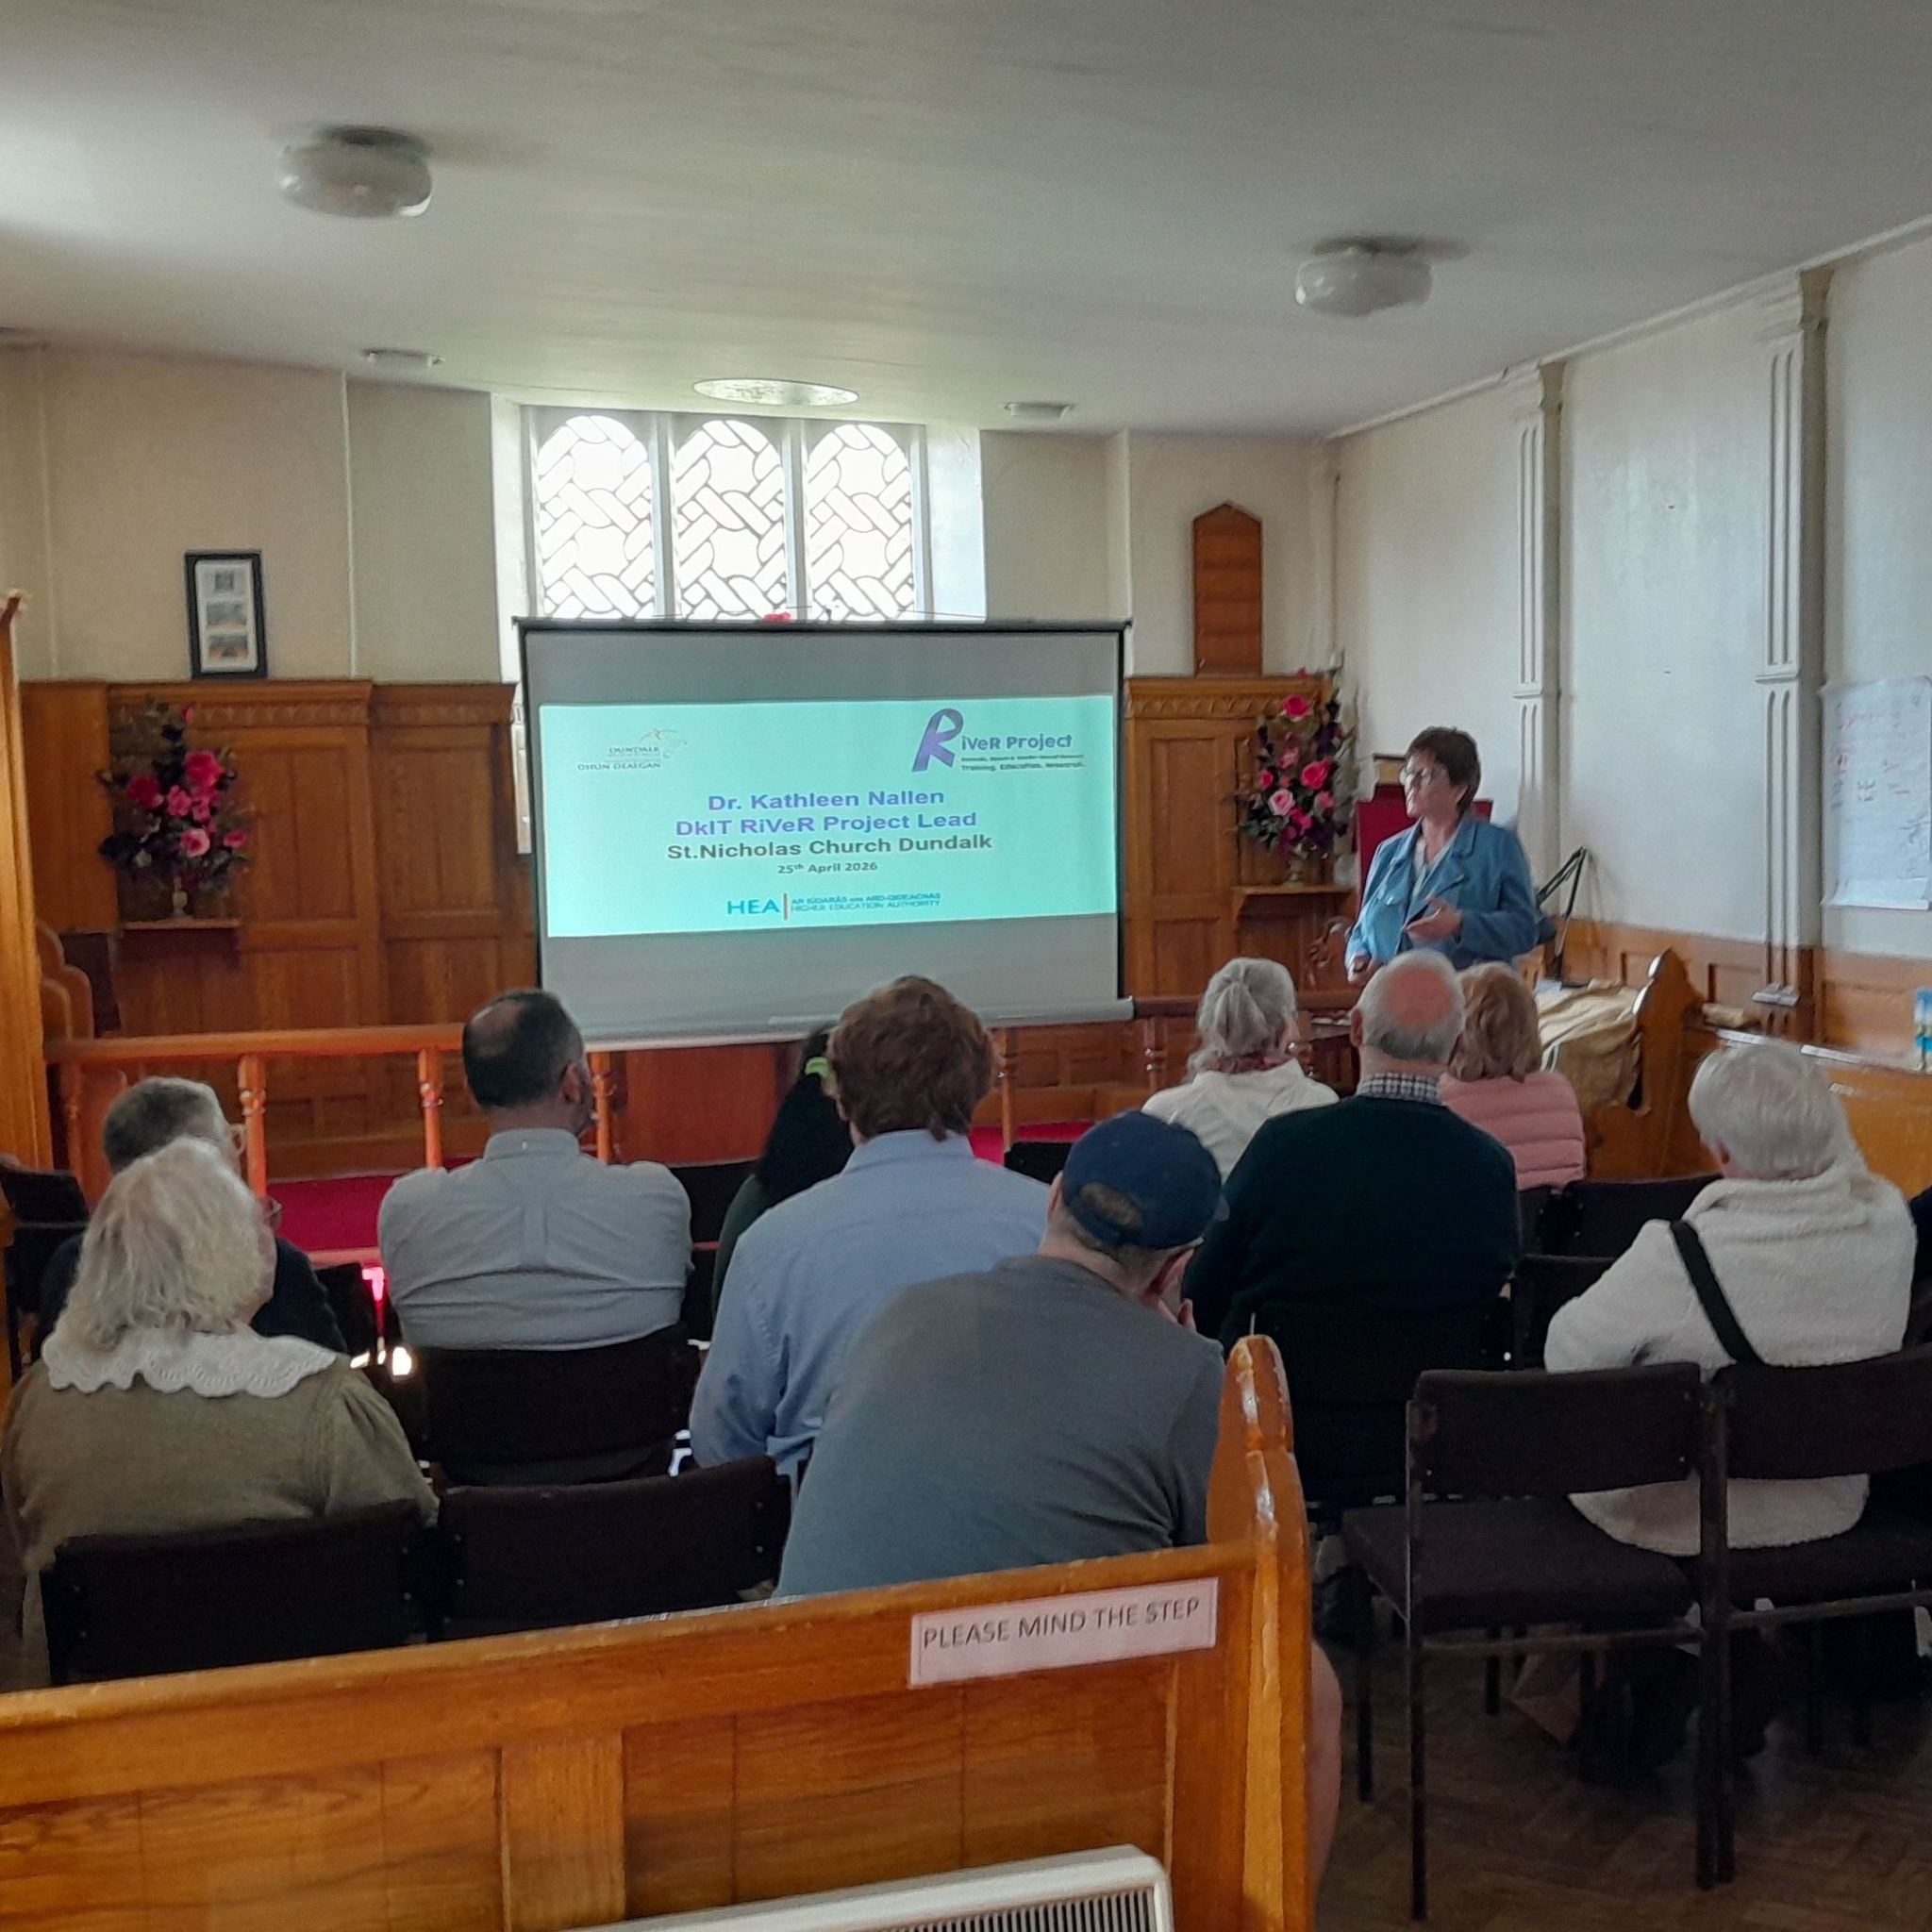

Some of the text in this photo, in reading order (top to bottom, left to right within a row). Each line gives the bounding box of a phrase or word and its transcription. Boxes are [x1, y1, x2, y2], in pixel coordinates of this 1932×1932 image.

[1007, 733, 1073, 752] Project
[708, 791, 944, 810] Dr. Kathleen Nallen
[676, 812, 976, 836] DkIT RiVeR Project Lead
[668, 834, 992, 859] St.Nicholas Church Dundalk
[808, 862, 841, 874] April
[844, 862, 878, 872] 2026
[727, 898, 780, 915] HEA
[924, 1596, 1200, 1650] PLEASE MIND THE STEP
